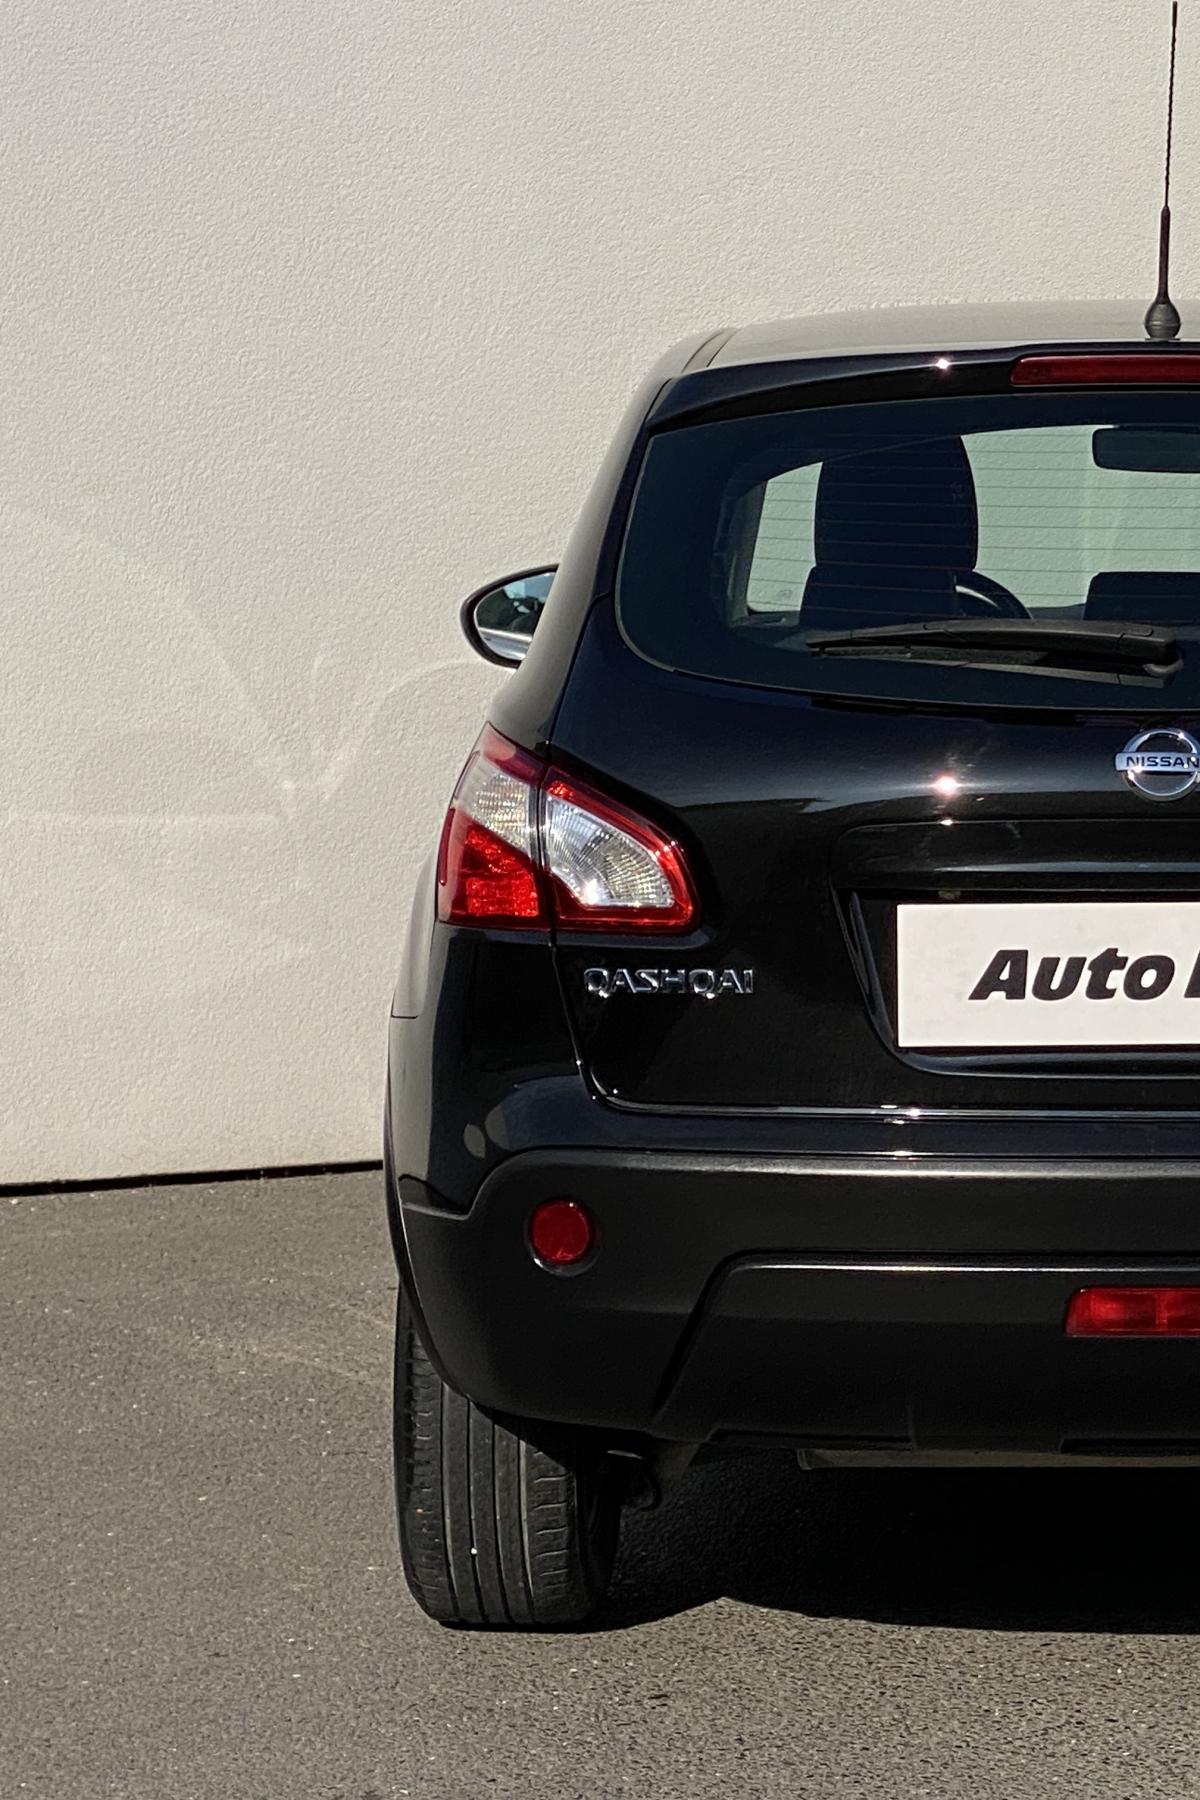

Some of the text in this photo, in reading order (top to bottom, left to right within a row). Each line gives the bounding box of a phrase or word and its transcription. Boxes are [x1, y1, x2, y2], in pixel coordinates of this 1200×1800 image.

[1126, 756, 1200, 768] NISSAN
[583, 967, 753, 999] QASHQAI
[968, 947, 1175, 1001] Auto
